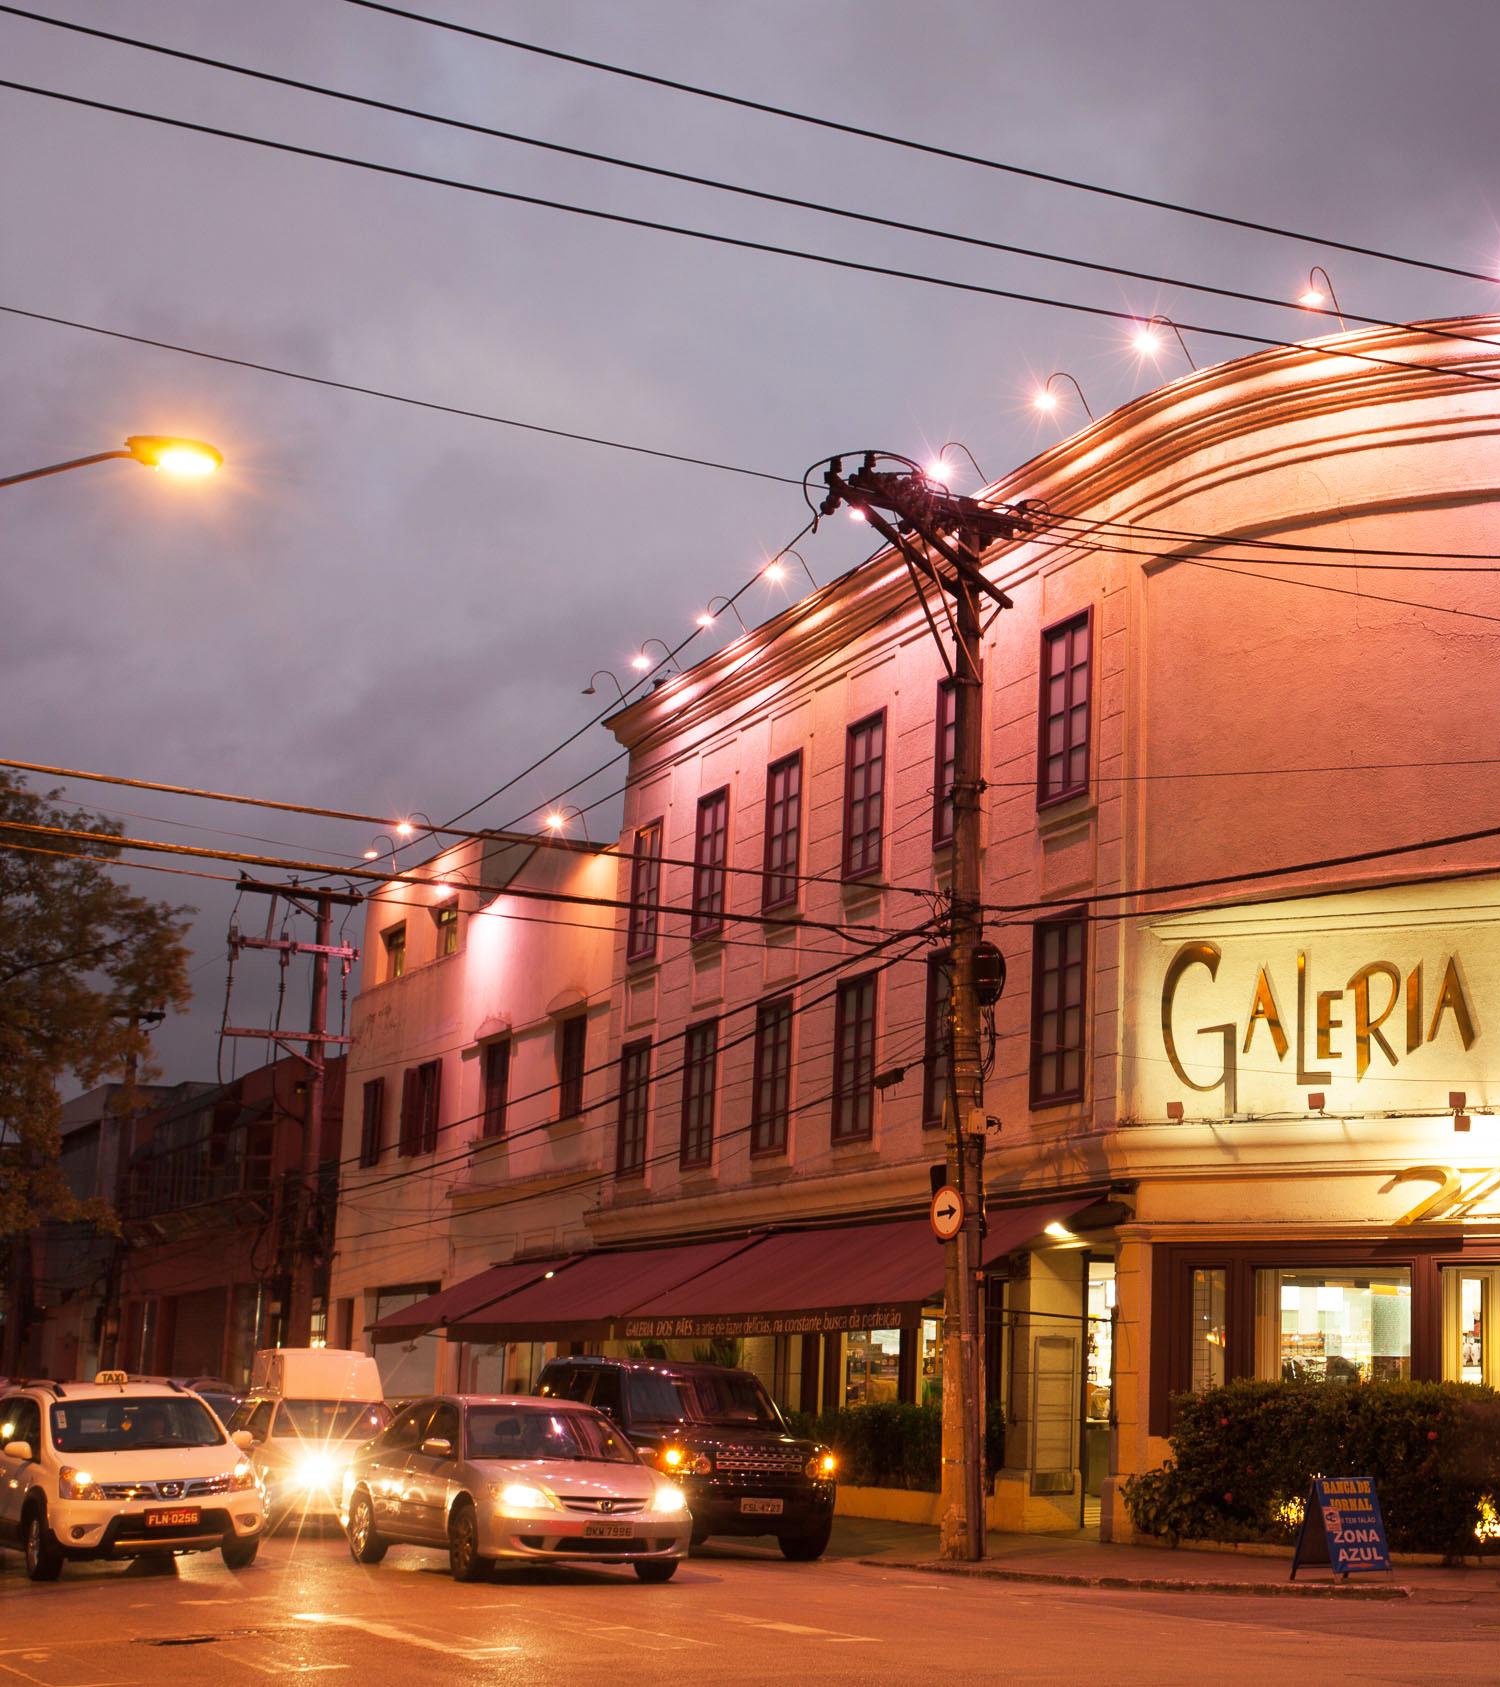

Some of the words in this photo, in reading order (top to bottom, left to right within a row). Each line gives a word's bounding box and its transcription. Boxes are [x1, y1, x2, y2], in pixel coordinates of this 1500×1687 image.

[1162, 940, 1478, 1117] GALERIA
[626, 1321, 653, 1337] GALERIA
[655, 1320, 674, 1337] DOS
[773, 1320, 783, 1332] na
[784, 1315, 822, 1332] constante
[823, 1312, 847, 1331] busca
[849, 1309, 861, 1328] da
[862, 1308, 902, 1330] perfeição
[101, 1373, 125, 1383] TAXI
[1333, 1529, 1380, 1543] ZONA
[1338, 1547, 1384, 1562] AZUL
